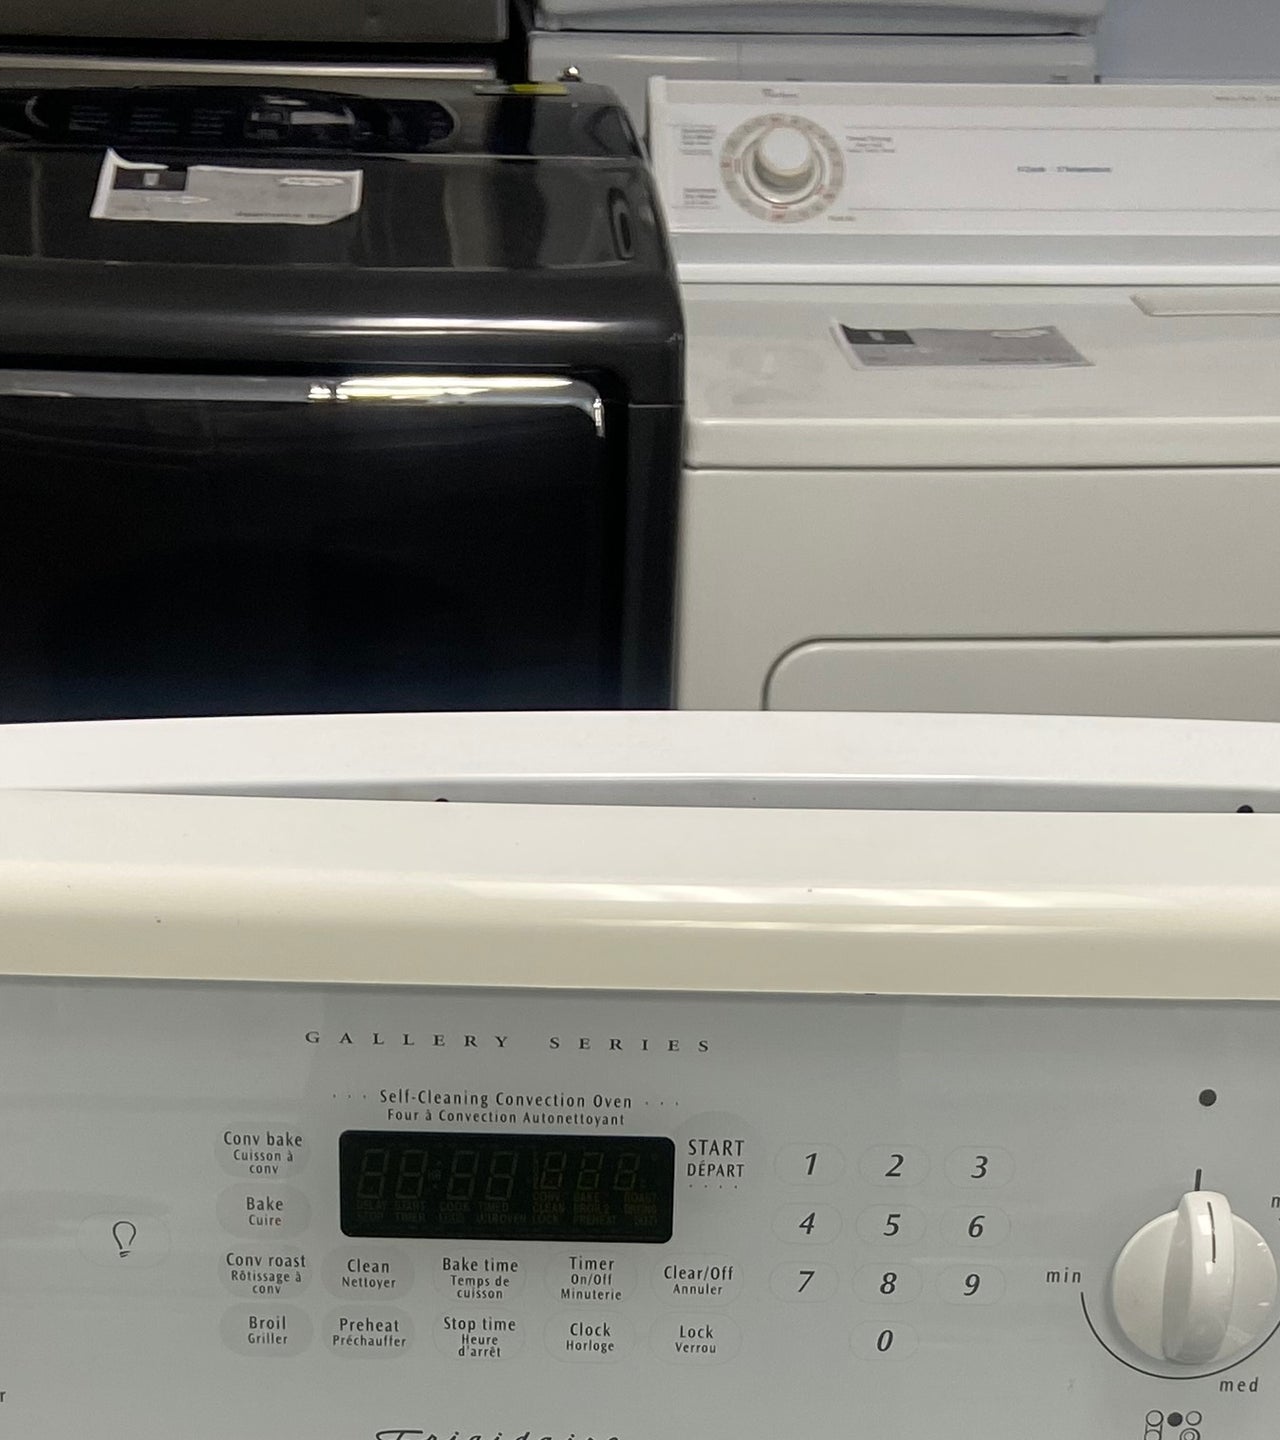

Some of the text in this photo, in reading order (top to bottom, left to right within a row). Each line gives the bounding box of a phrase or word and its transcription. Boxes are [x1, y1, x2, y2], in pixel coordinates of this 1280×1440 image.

[305, 1031, 709, 1053] GALLERY SERIES
[379, 1088, 632, 1109] Self-Cleaning Convection Oven
[387, 1108, 624, 1128] Four à Convection Autonettoyant
[223, 1130, 303, 1148] Conv bake
[233, 1148, 294, 1163] Cuisson à
[688, 1138, 745, 1157] START
[249, 1164, 279, 1175] conv
[687, 1159, 745, 1178] DÉPART
[805, 1152, 817, 1176] 1
[884, 1153, 904, 1177] 2
[970, 1155, 988, 1179] 3
[246, 1195, 284, 1212] Bake
[248, 1214, 282, 1227] Cuire
[798, 1212, 816, 1235] 4
[883, 1213, 901, 1237] 5
[968, 1215, 986, 1238] 6
[226, 1252, 306, 1268] Conv roast
[347, 1258, 390, 1274] Clean
[442, 1256, 519, 1273] Bake time
[568, 1256, 615, 1271] Timer
[231, 1269, 302, 1285] Rôtissage à
[570, 1273, 612, 1286] On/Off
[663, 1264, 734, 1281] Clear/Off
[1046, 1266, 1081, 1284] min
[252, 1284, 281, 1295] conv
[341, 1276, 396, 1290] Nettoyer
[450, 1274, 510, 1289] Temps de
[672, 1282, 723, 1296] Annuler
[797, 1270, 816, 1293] 7
[879, 1272, 898, 1295] 8
[963, 1273, 981, 1297] 9
[456, 1287, 503, 1299] cuisson
[560, 1288, 622, 1301] Minuterie
[249, 1315, 286, 1330] Broil
[338, 1316, 400, 1334] Preheat
[443, 1316, 516, 1334] Stop time
[570, 1321, 611, 1337] Clock
[247, 1332, 288, 1345] Griller
[461, 1333, 499, 1346] Heure
[679, 1324, 714, 1339] Lock
[332, 1334, 407, 1347] Préchauffer
[566, 1339, 615, 1355] Horloge
[674, 1341, 716, 1354] Verrou
[876, 1329, 894, 1352] 0
[458, 1345, 501, 1358] d'arrêt
[1219, 1376, 1259, 1393] med
